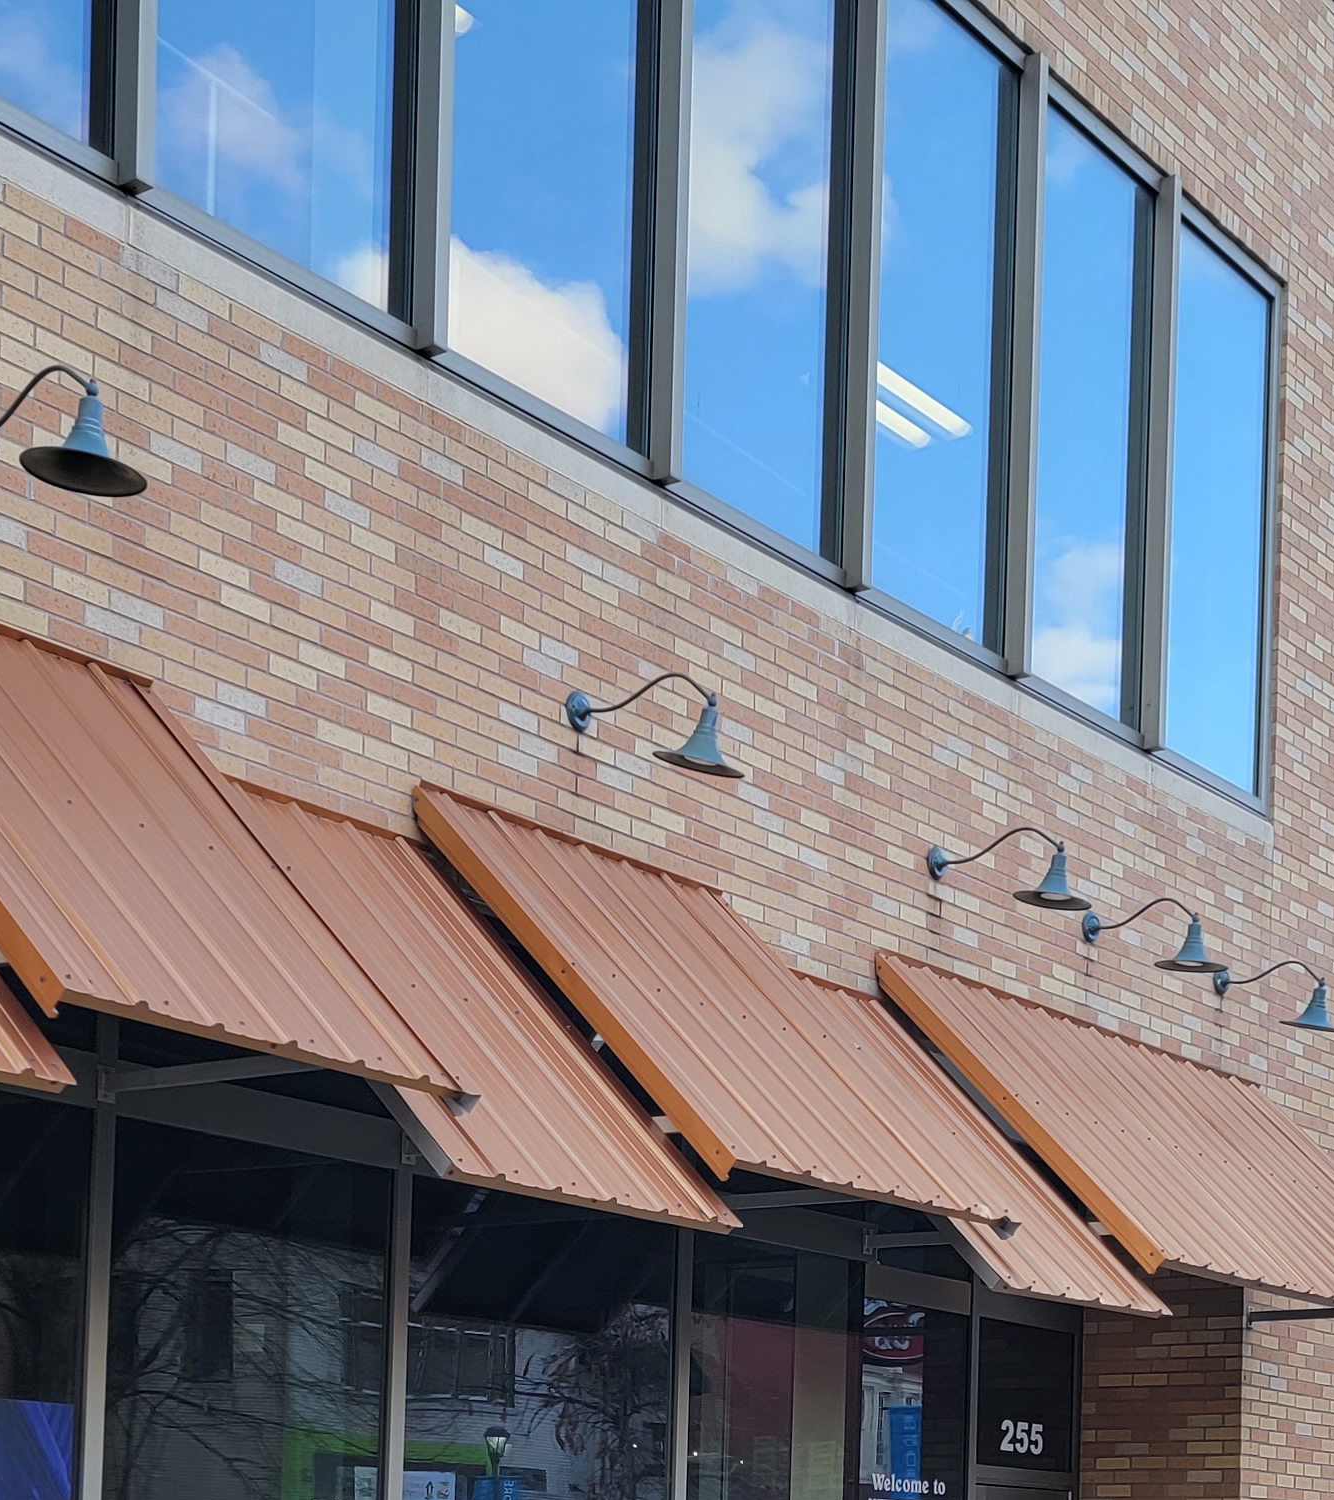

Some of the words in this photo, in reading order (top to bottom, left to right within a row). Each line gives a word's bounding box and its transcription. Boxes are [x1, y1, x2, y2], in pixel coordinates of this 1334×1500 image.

[1000, 1419, 1043, 1455] 255
[871, 1473, 929, 1494] Welcome
[933, 1478, 946, 1496] to
